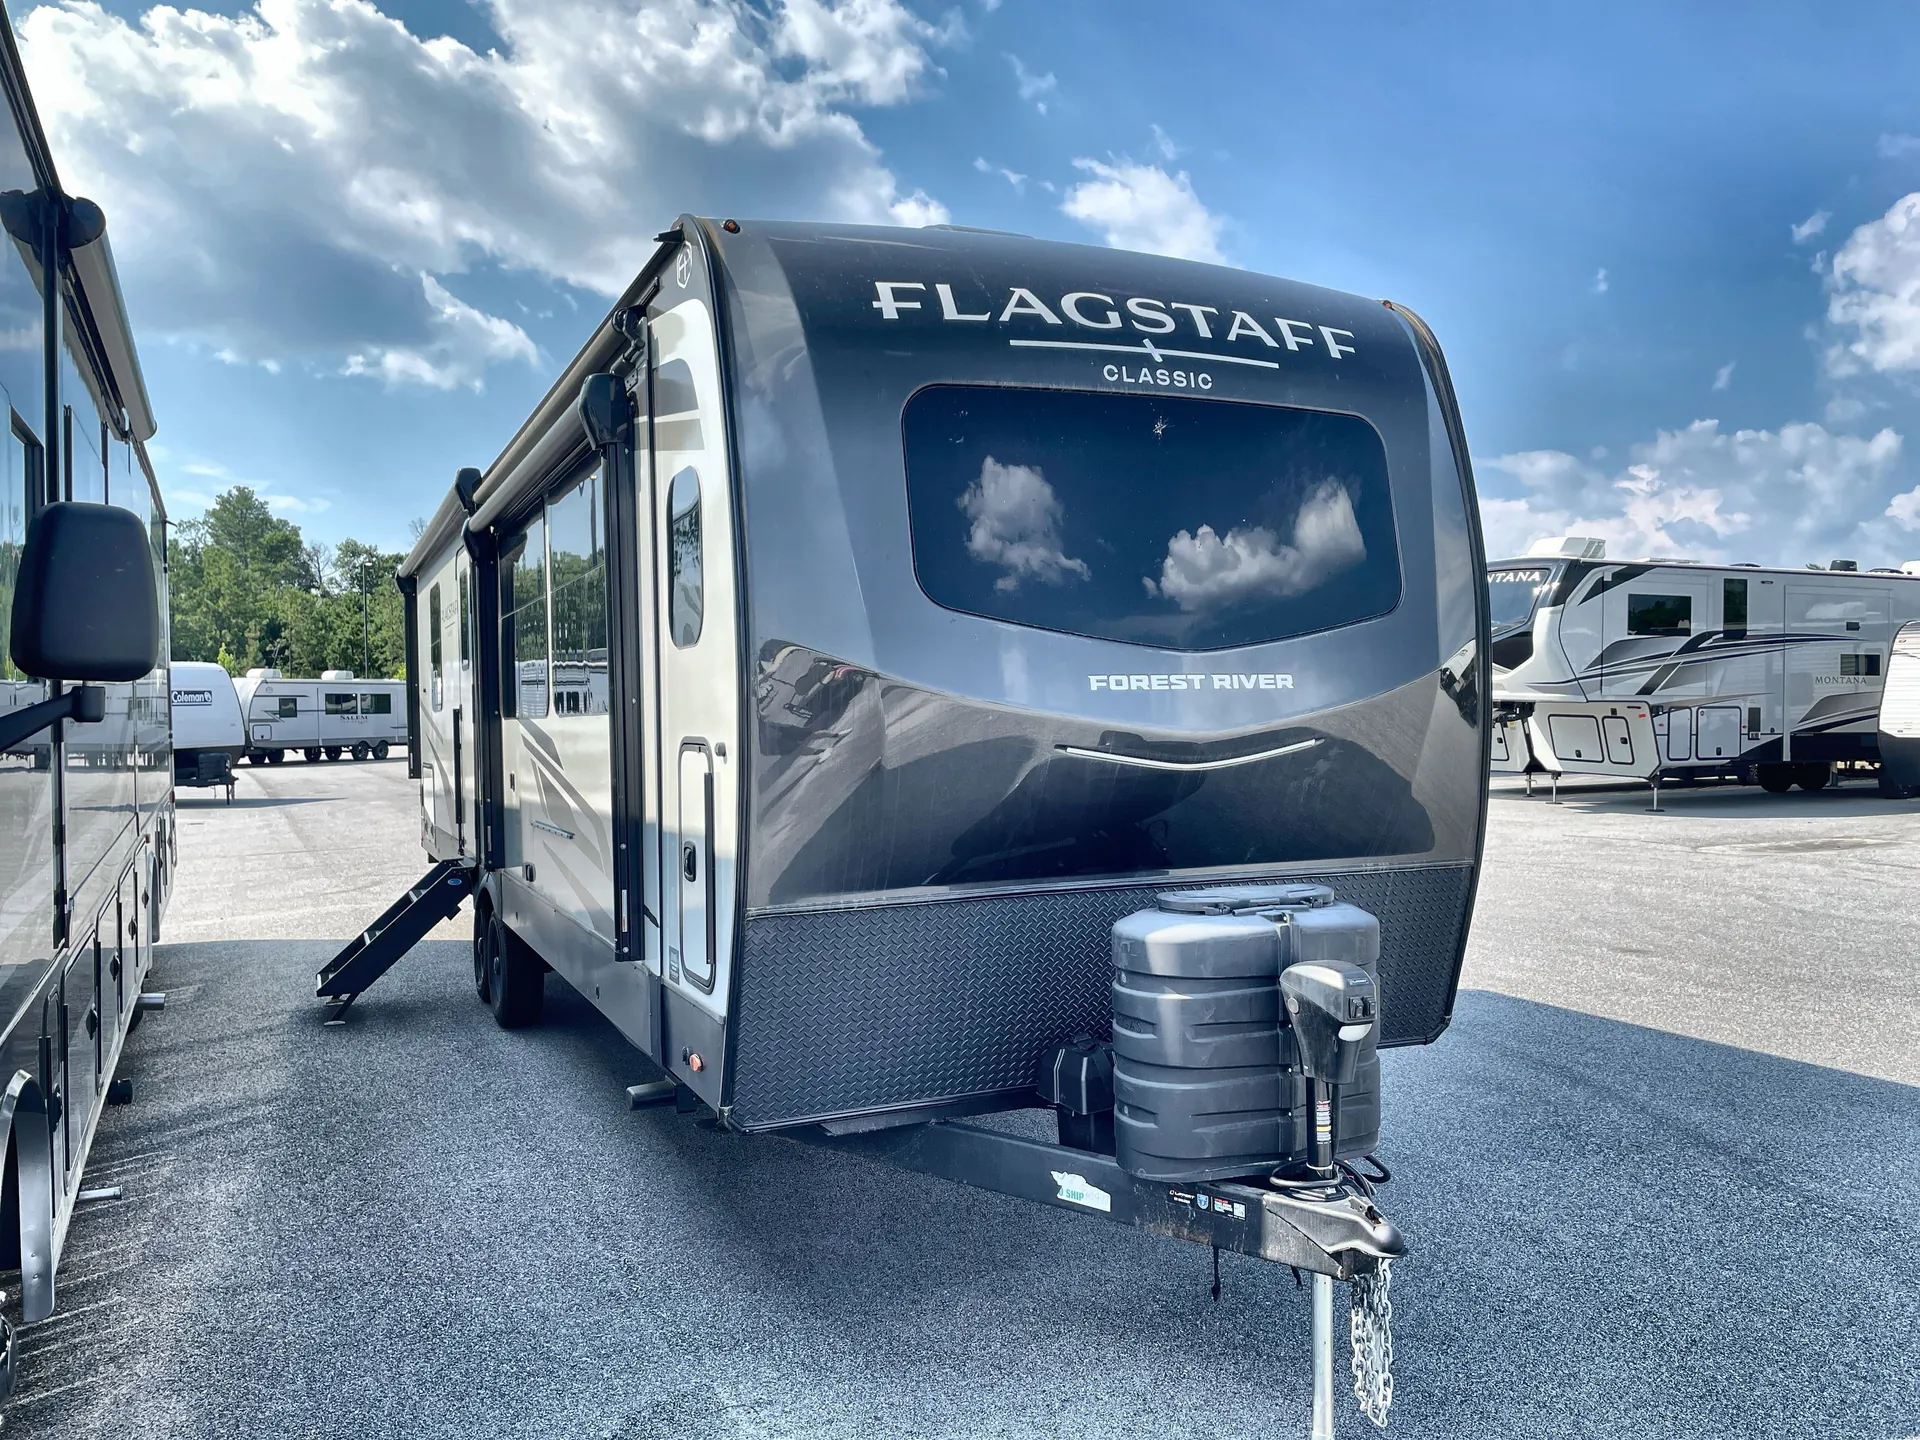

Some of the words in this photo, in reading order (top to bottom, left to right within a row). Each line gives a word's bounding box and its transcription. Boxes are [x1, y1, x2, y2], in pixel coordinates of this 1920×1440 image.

[872, 281, 1356, 360] FLAGSTAFF
[1103, 364, 1213, 391] CLASSIC
[1487, 571, 1540, 583] NTANA
[1087, 674, 1206, 691] FOREST
[1210, 673, 1295, 690] RIVER
[1815, 675, 1867, 685] MONTANA
[172, 691, 204, 702] Coleman
[1065, 1188, 1085, 1201] SHIP
